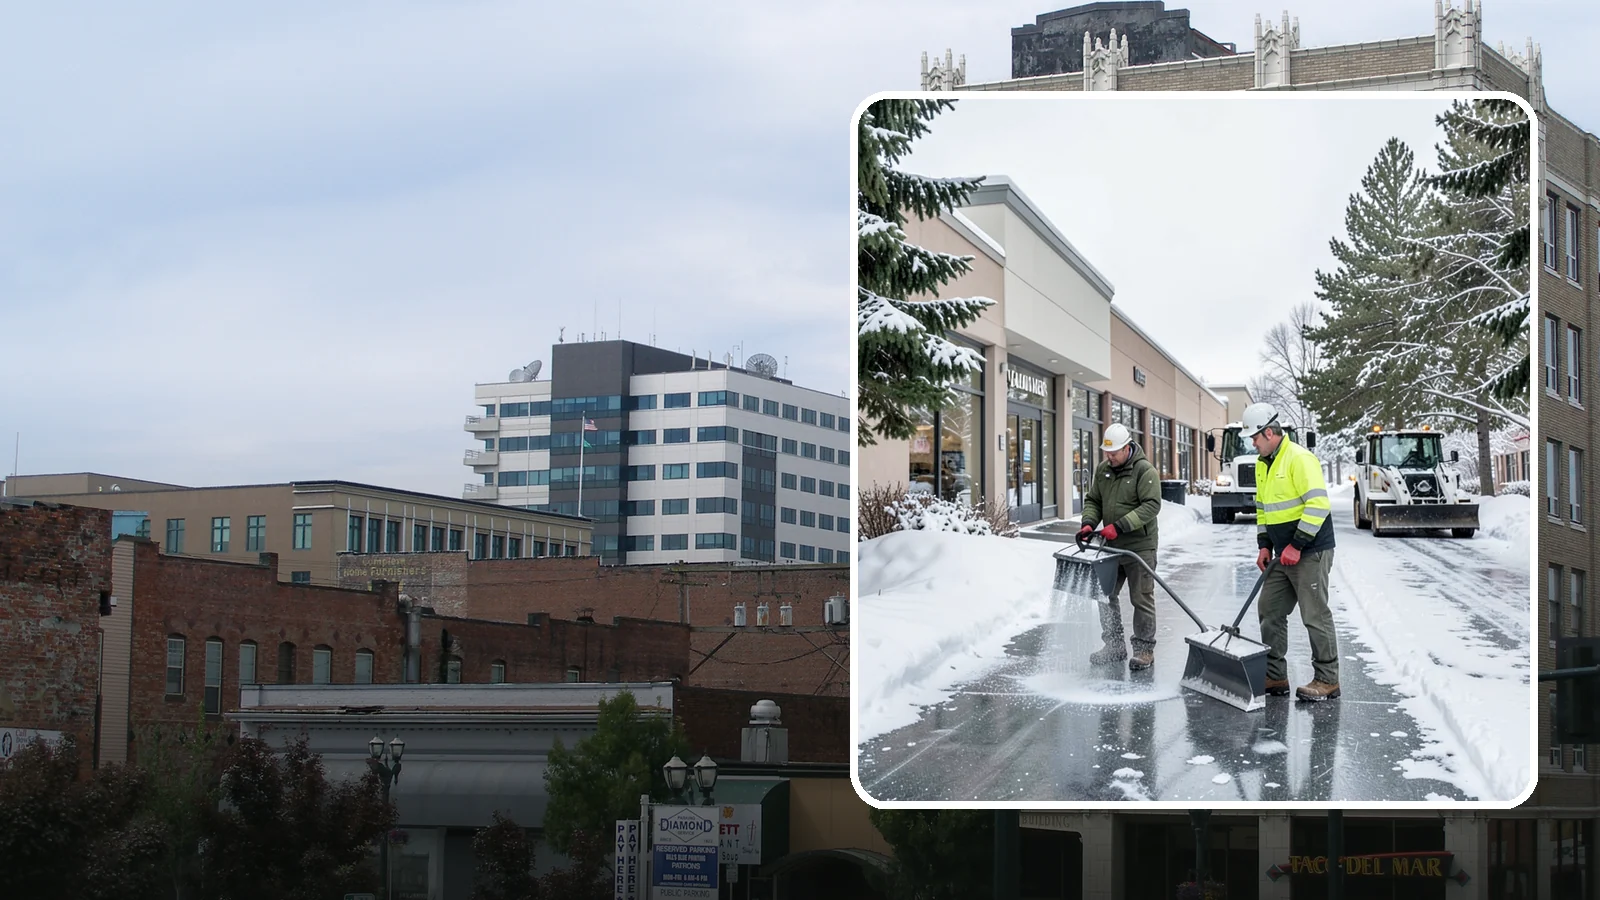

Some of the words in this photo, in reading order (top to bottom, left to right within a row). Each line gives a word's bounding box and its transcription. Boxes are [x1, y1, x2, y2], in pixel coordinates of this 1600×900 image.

[370, 566, 427, 576] Furnishers
[660, 818, 713, 833] DIAMOND
[1022, 815, 1070, 828] BUILDING
[617, 825, 625, 852] PAY
[628, 825, 637, 852] PAY
[656, 845, 688, 853] RESERVED
[689, 846, 716, 854] PARKING
[722, 852, 739, 862] Soup
[671, 862, 701, 870] PATRONS
[1289, 855, 1328, 874] TAC
[1345, 857, 1384, 875] DEL
[1392, 857, 1442, 877] MAR
[616, 856, 625, 893] HERE
[627, 856, 636, 893] HERE
[660, 889, 682, 897] PUBLIC
[683, 890, 710, 898] PARKING
